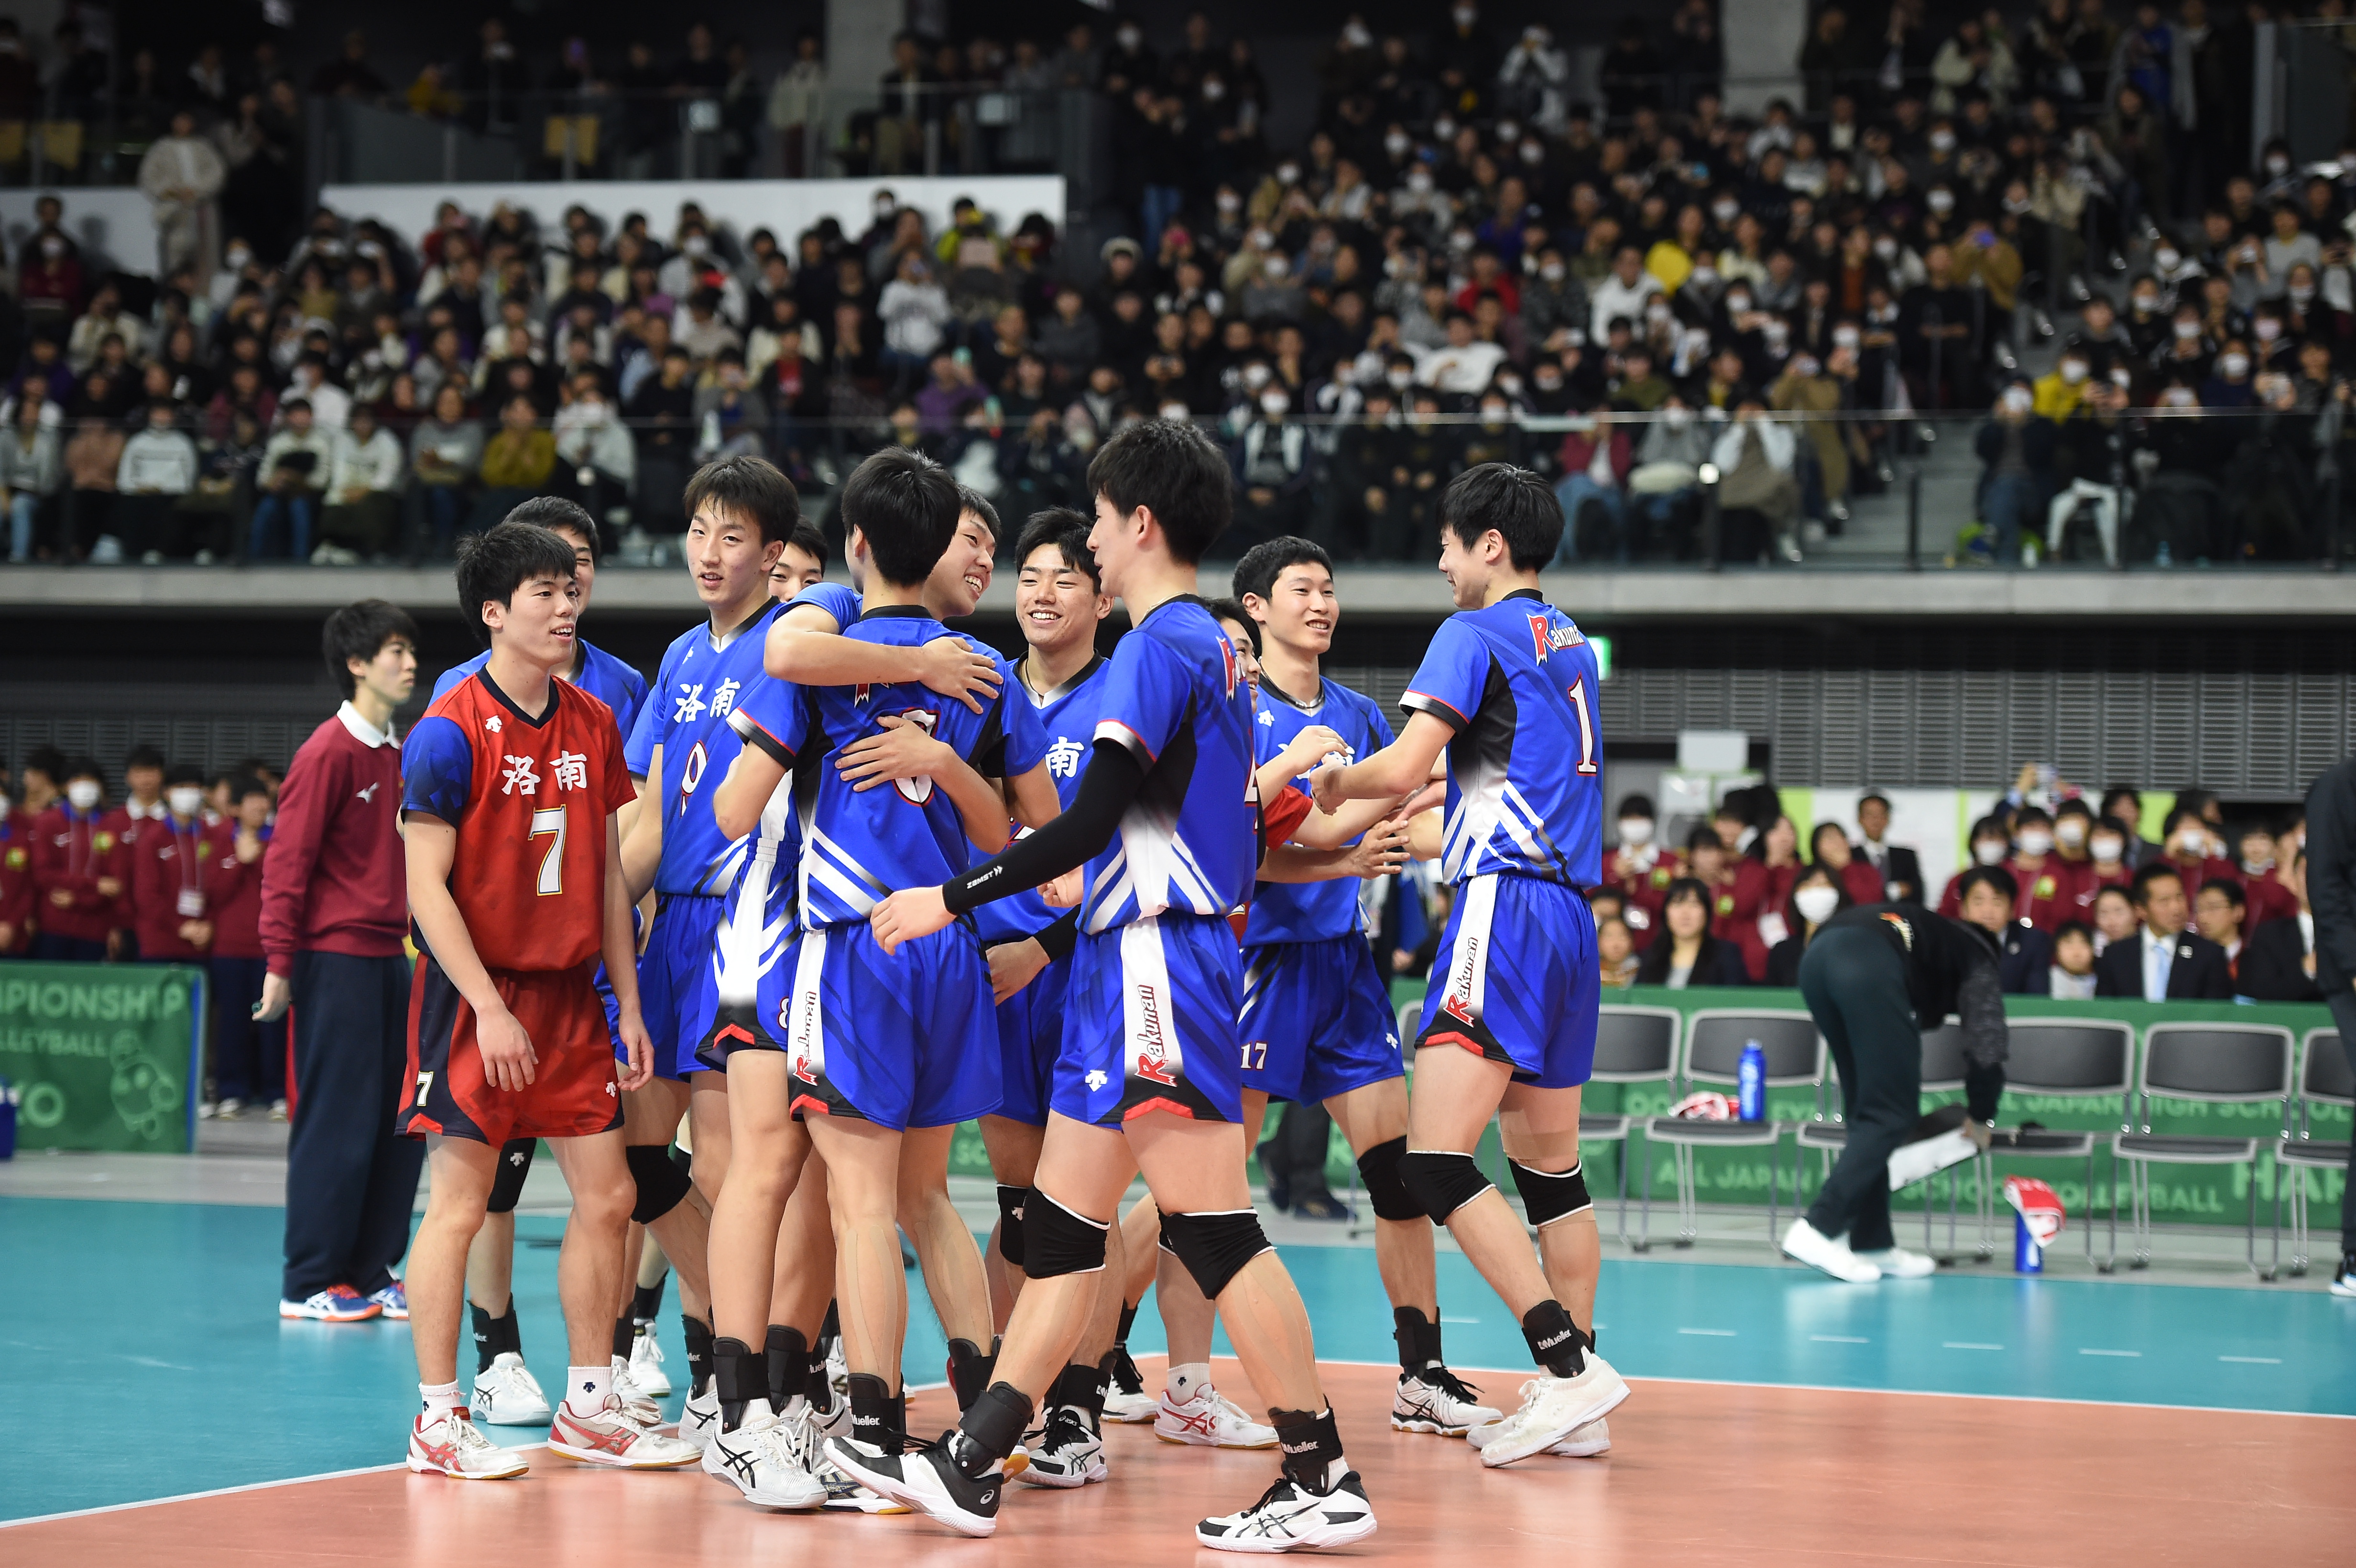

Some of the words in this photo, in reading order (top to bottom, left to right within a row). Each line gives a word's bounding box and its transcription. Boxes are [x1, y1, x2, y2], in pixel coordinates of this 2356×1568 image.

[1526, 613, 1585, 666] Rakuna
[673, 677, 741, 723] 洛南
[1567, 671, 1598, 776] 1
[502, 750, 587, 795] 洛南
[1045, 736, 1084, 778] 南
[528, 804, 567, 896] 7
[967, 871, 993, 889] ZAMST
[0, 979, 186, 1021] PIONSHP
[1443, 937, 1475, 1028] Rakunan
[0, 1028, 107, 1057] LEYBALL
[1134, 985, 1178, 1088] Rakunan
[1240, 1041, 1267, 1070] 17
[416, 1071, 434, 1106] 7
[1538, 1329, 1571, 1350] Mueller
[851, 1414, 880, 1426] Mueller
[1281, 1440, 1319, 1454] Mueller
